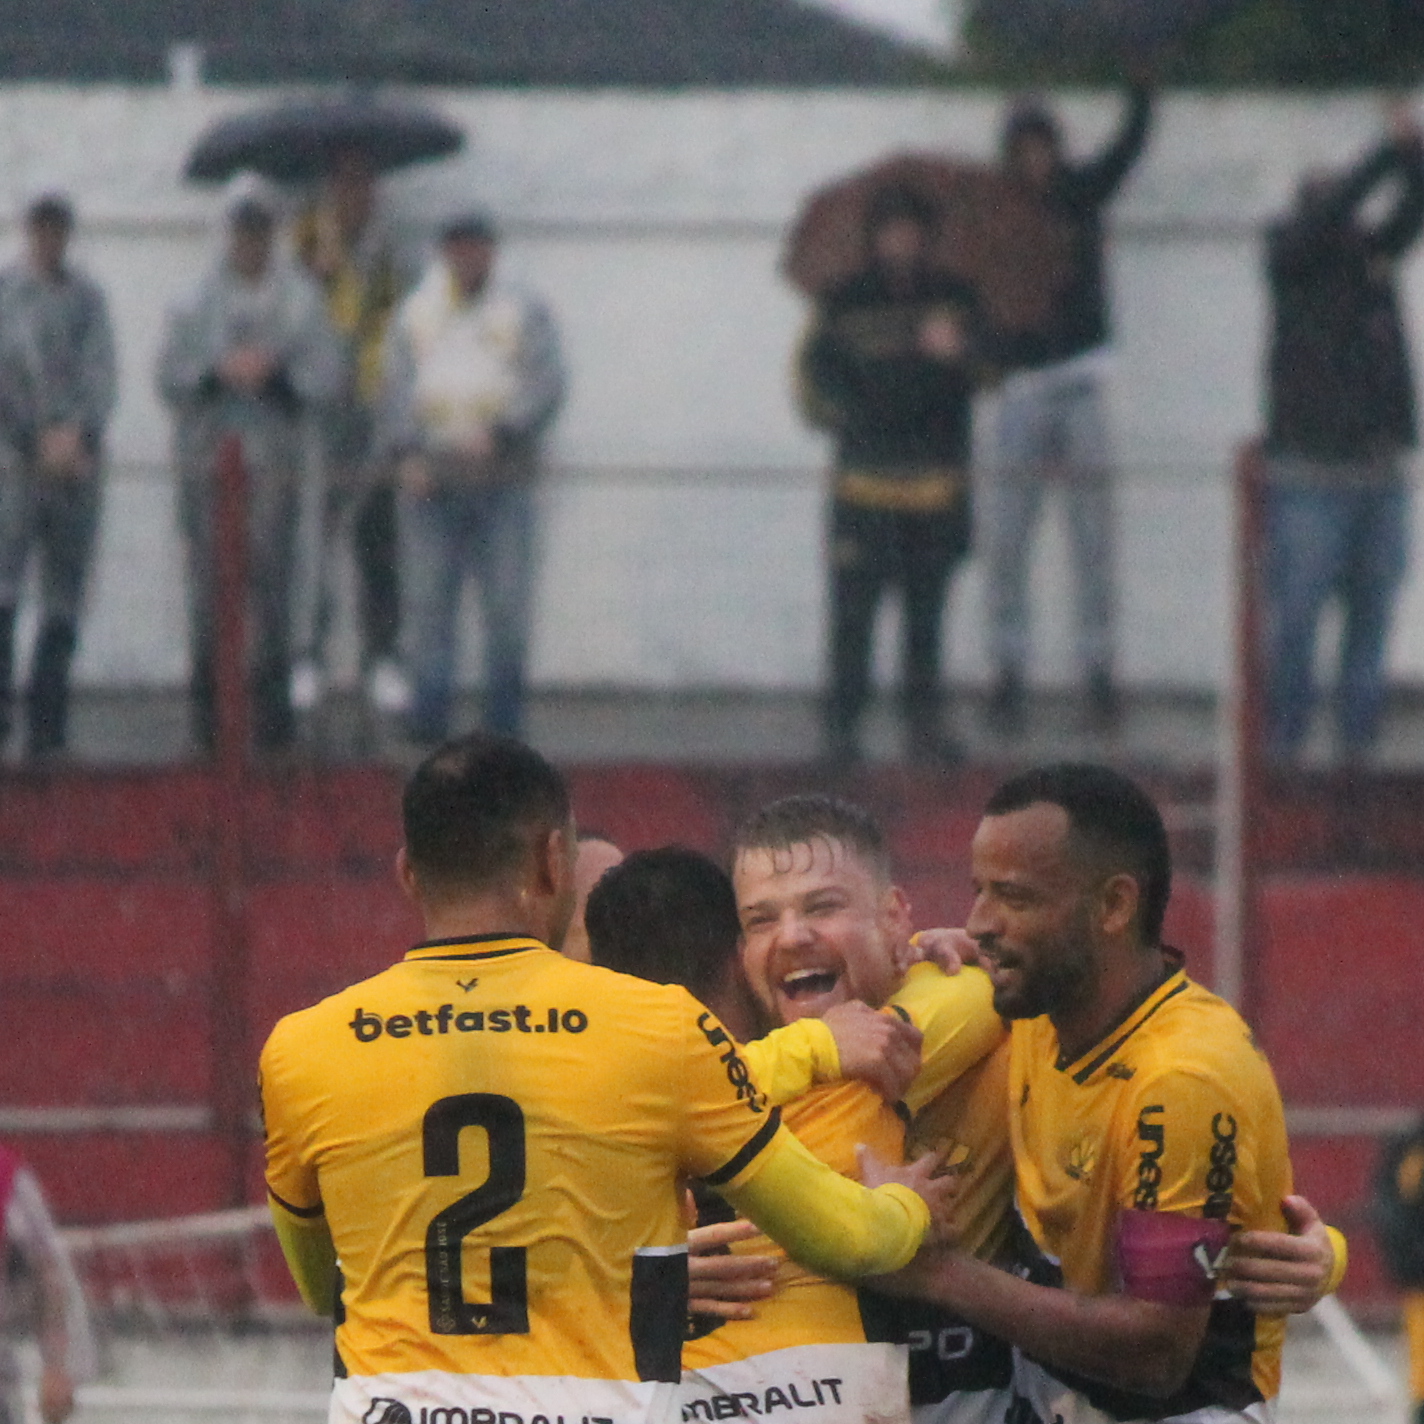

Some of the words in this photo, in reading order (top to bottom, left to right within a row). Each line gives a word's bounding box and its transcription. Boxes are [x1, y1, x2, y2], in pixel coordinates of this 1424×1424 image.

[348, 1003, 589, 1043] betfast.io
[1134, 1104, 1165, 1211] unes
[422, 1092, 530, 1336] 2
[681, 1377, 844, 1423] MBRALIT
